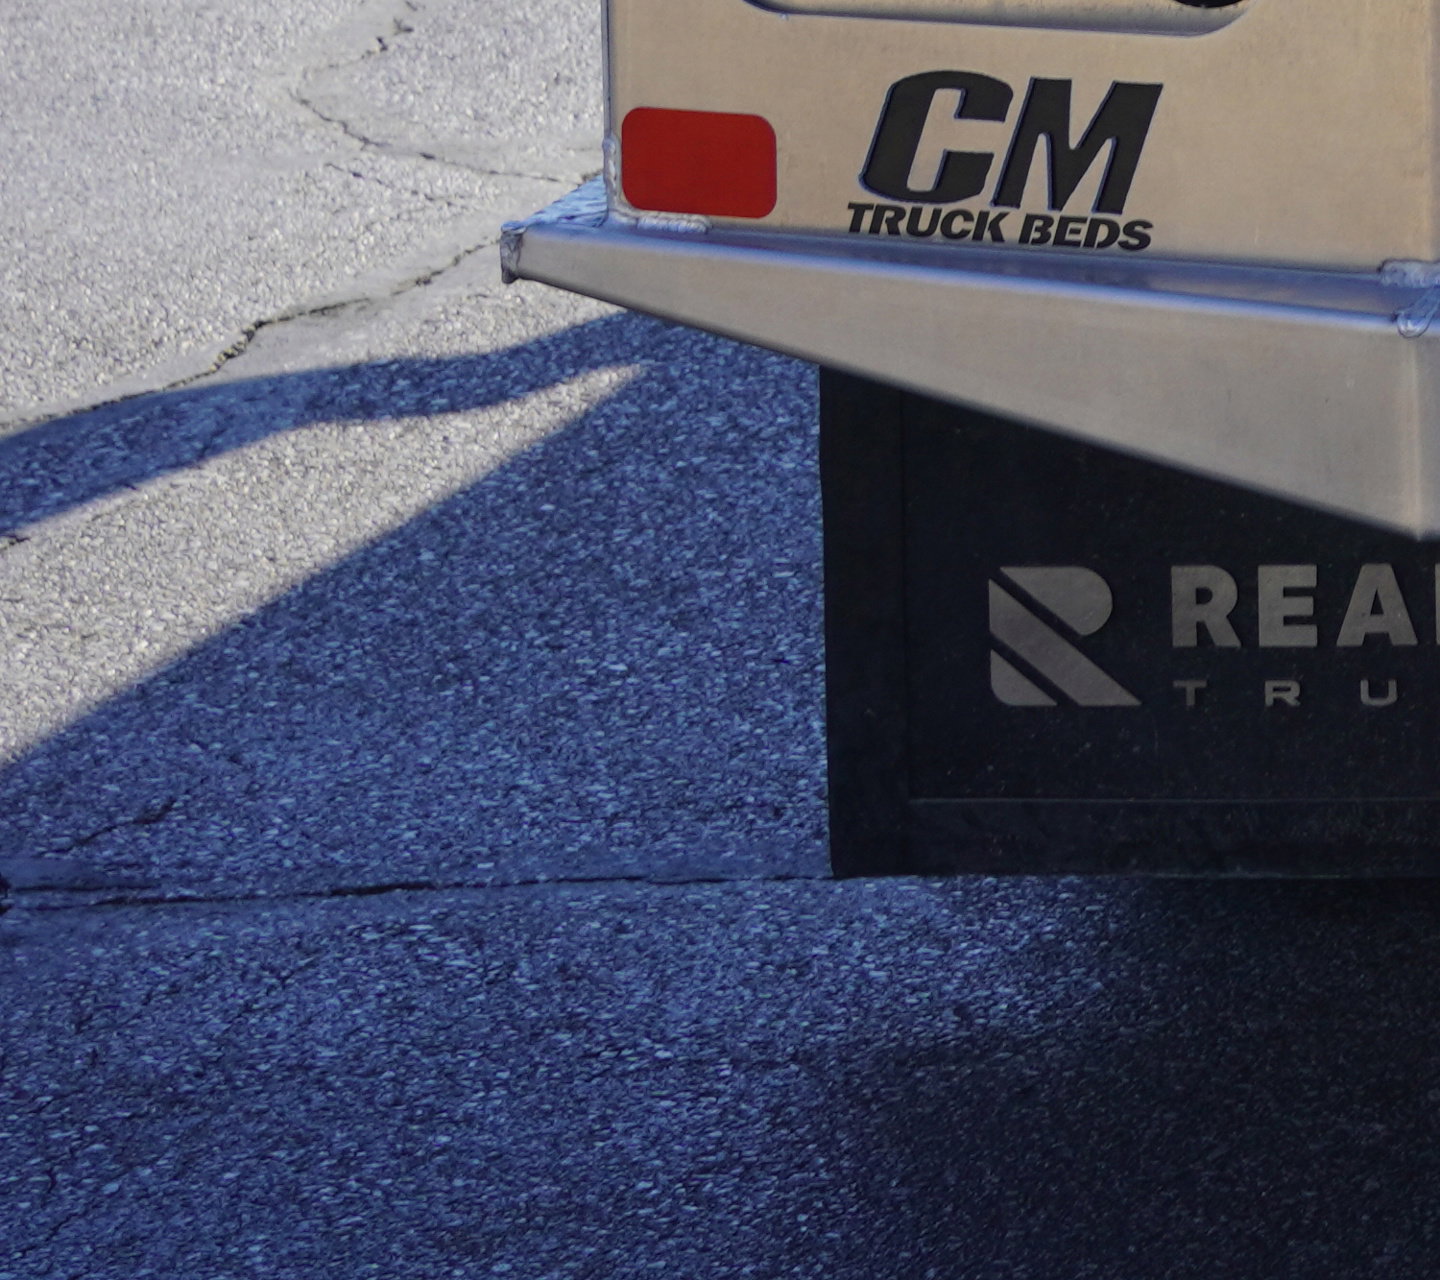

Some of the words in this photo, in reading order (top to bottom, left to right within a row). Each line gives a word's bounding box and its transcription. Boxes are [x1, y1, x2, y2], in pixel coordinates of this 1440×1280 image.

[858, 69, 1164, 215] CM
[847, 200, 1010, 244] TRUCK
[1018, 212, 1154, 252] BEDS
